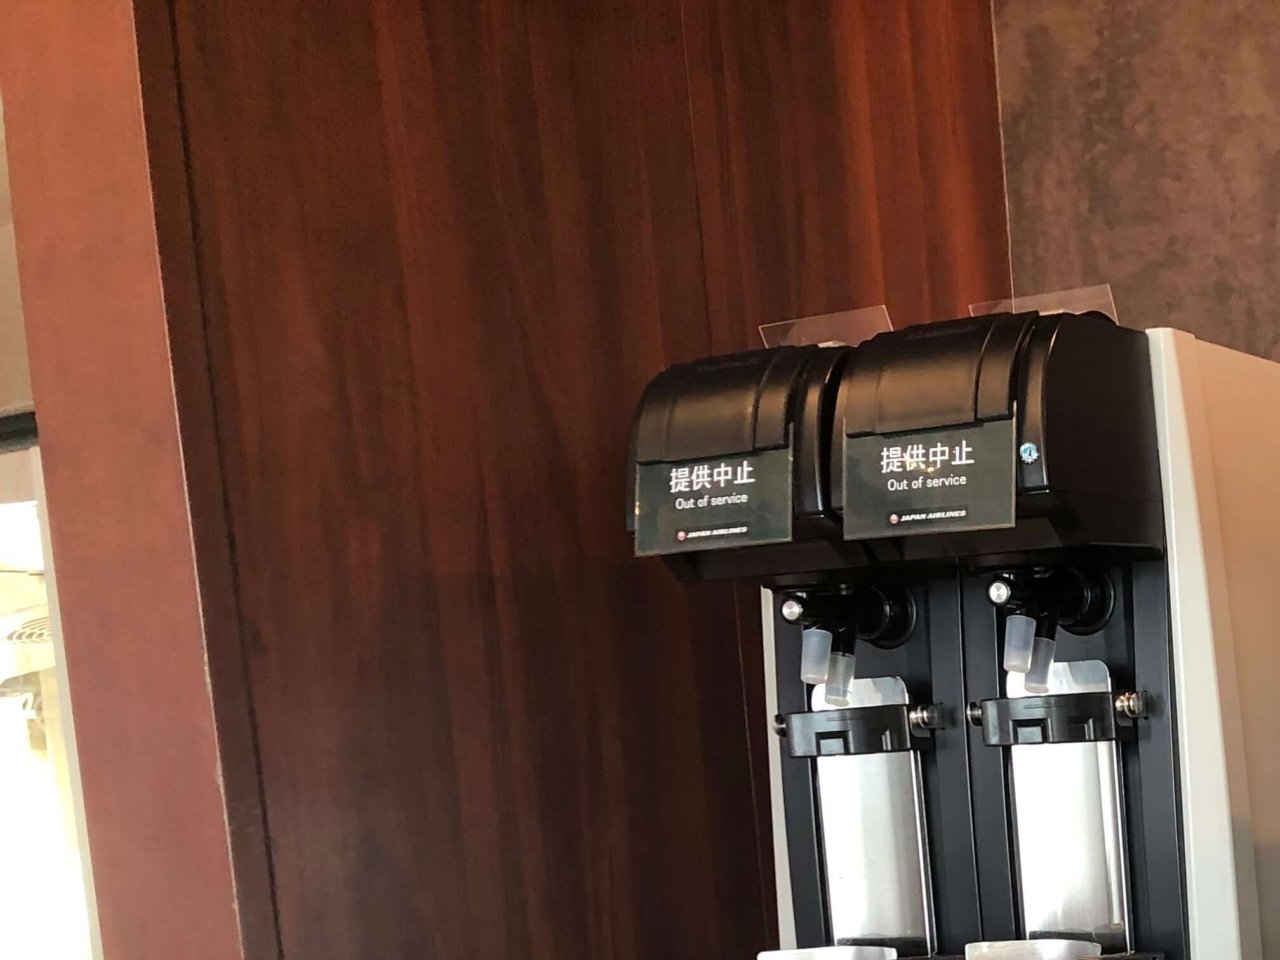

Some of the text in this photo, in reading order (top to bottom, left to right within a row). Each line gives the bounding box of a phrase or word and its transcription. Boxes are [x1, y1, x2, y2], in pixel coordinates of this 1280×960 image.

[880, 439, 975, 474] 提供中止
[669, 460, 756, 493] 提供中止
[887, 473, 967, 491] Out of service
[675, 492, 748, 510] Out of service
[900, 510, 967, 522] JAPAN AIRLINES
